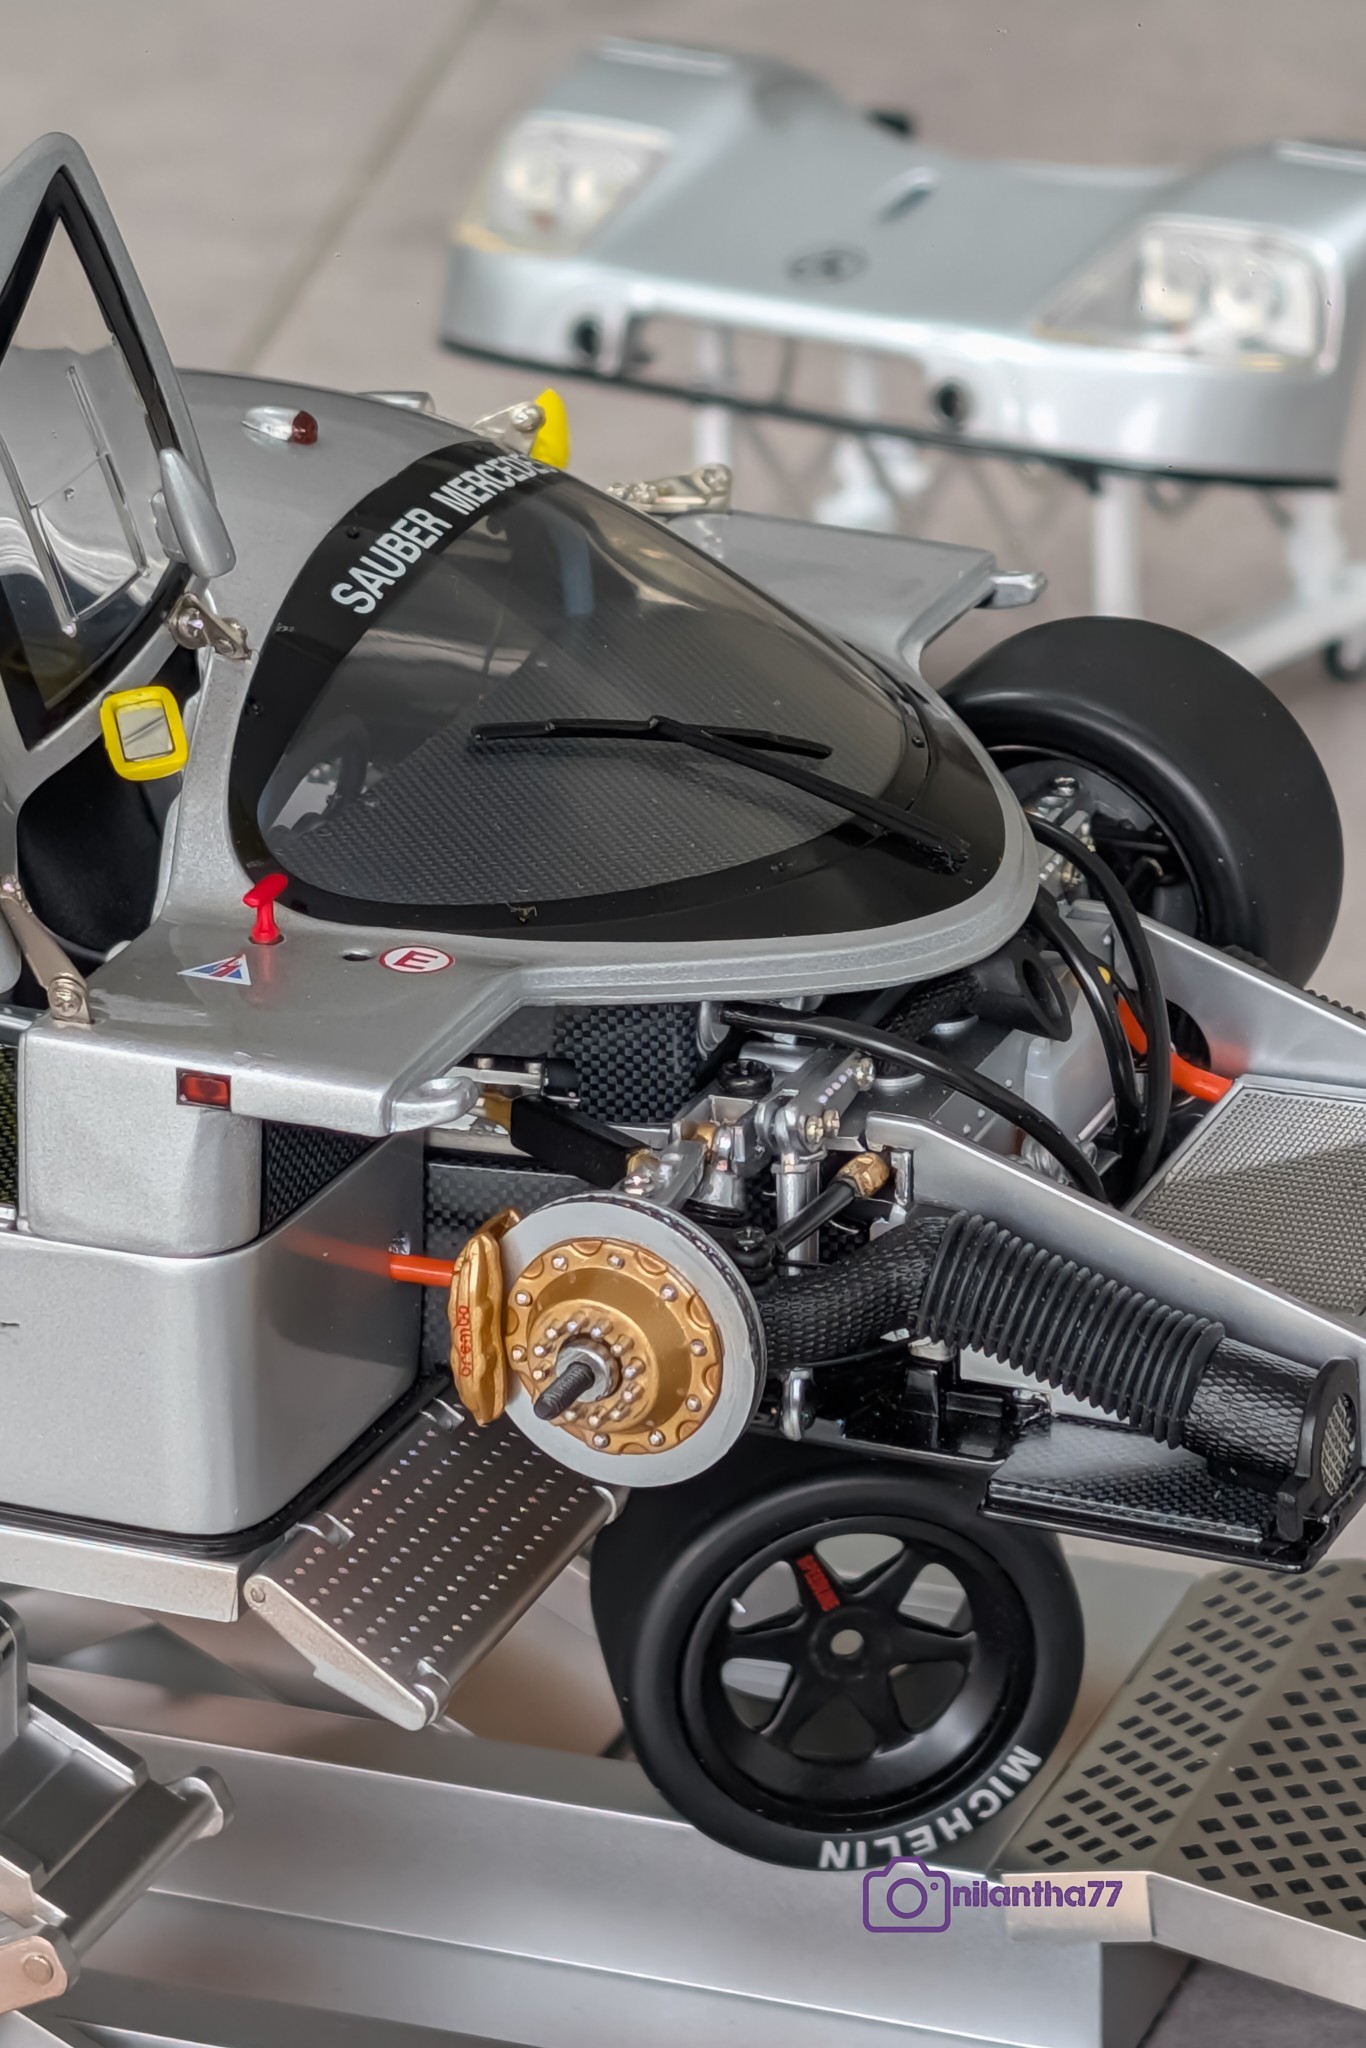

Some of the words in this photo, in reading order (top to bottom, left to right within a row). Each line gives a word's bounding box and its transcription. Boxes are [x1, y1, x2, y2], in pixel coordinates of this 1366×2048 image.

[331, 508, 453, 614] SAUBER
[393, 950, 439, 970] E
[818, 1745, 1042, 1870] MICHELIN
